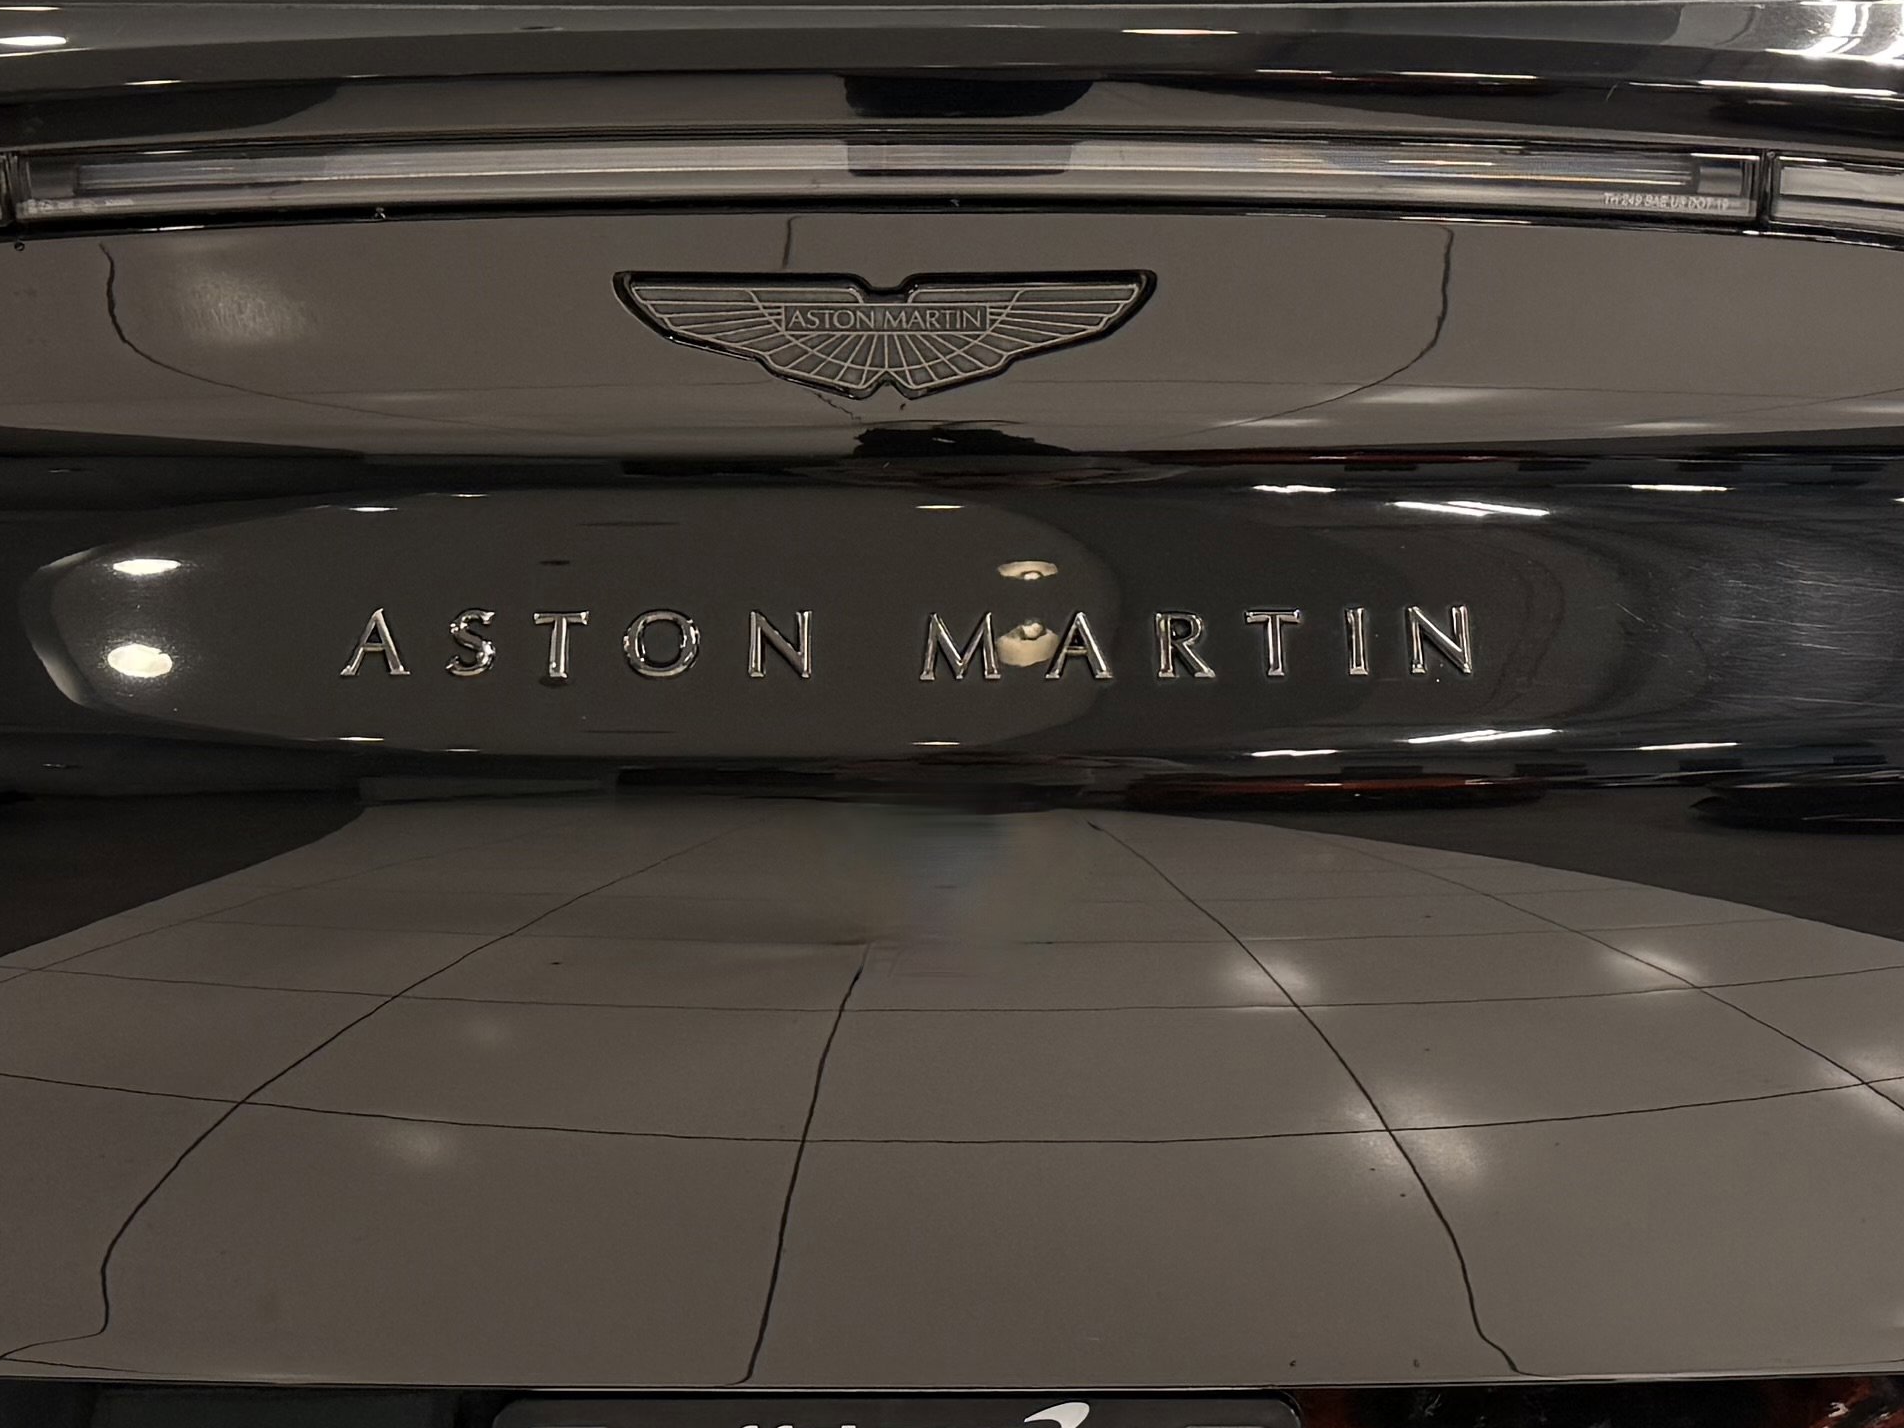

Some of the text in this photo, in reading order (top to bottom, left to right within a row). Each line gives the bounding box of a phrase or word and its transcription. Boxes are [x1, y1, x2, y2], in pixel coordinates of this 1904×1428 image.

[788, 309, 982, 329] ASTON MARTIN
[340, 604, 1475, 681] ASTON MARTIN
